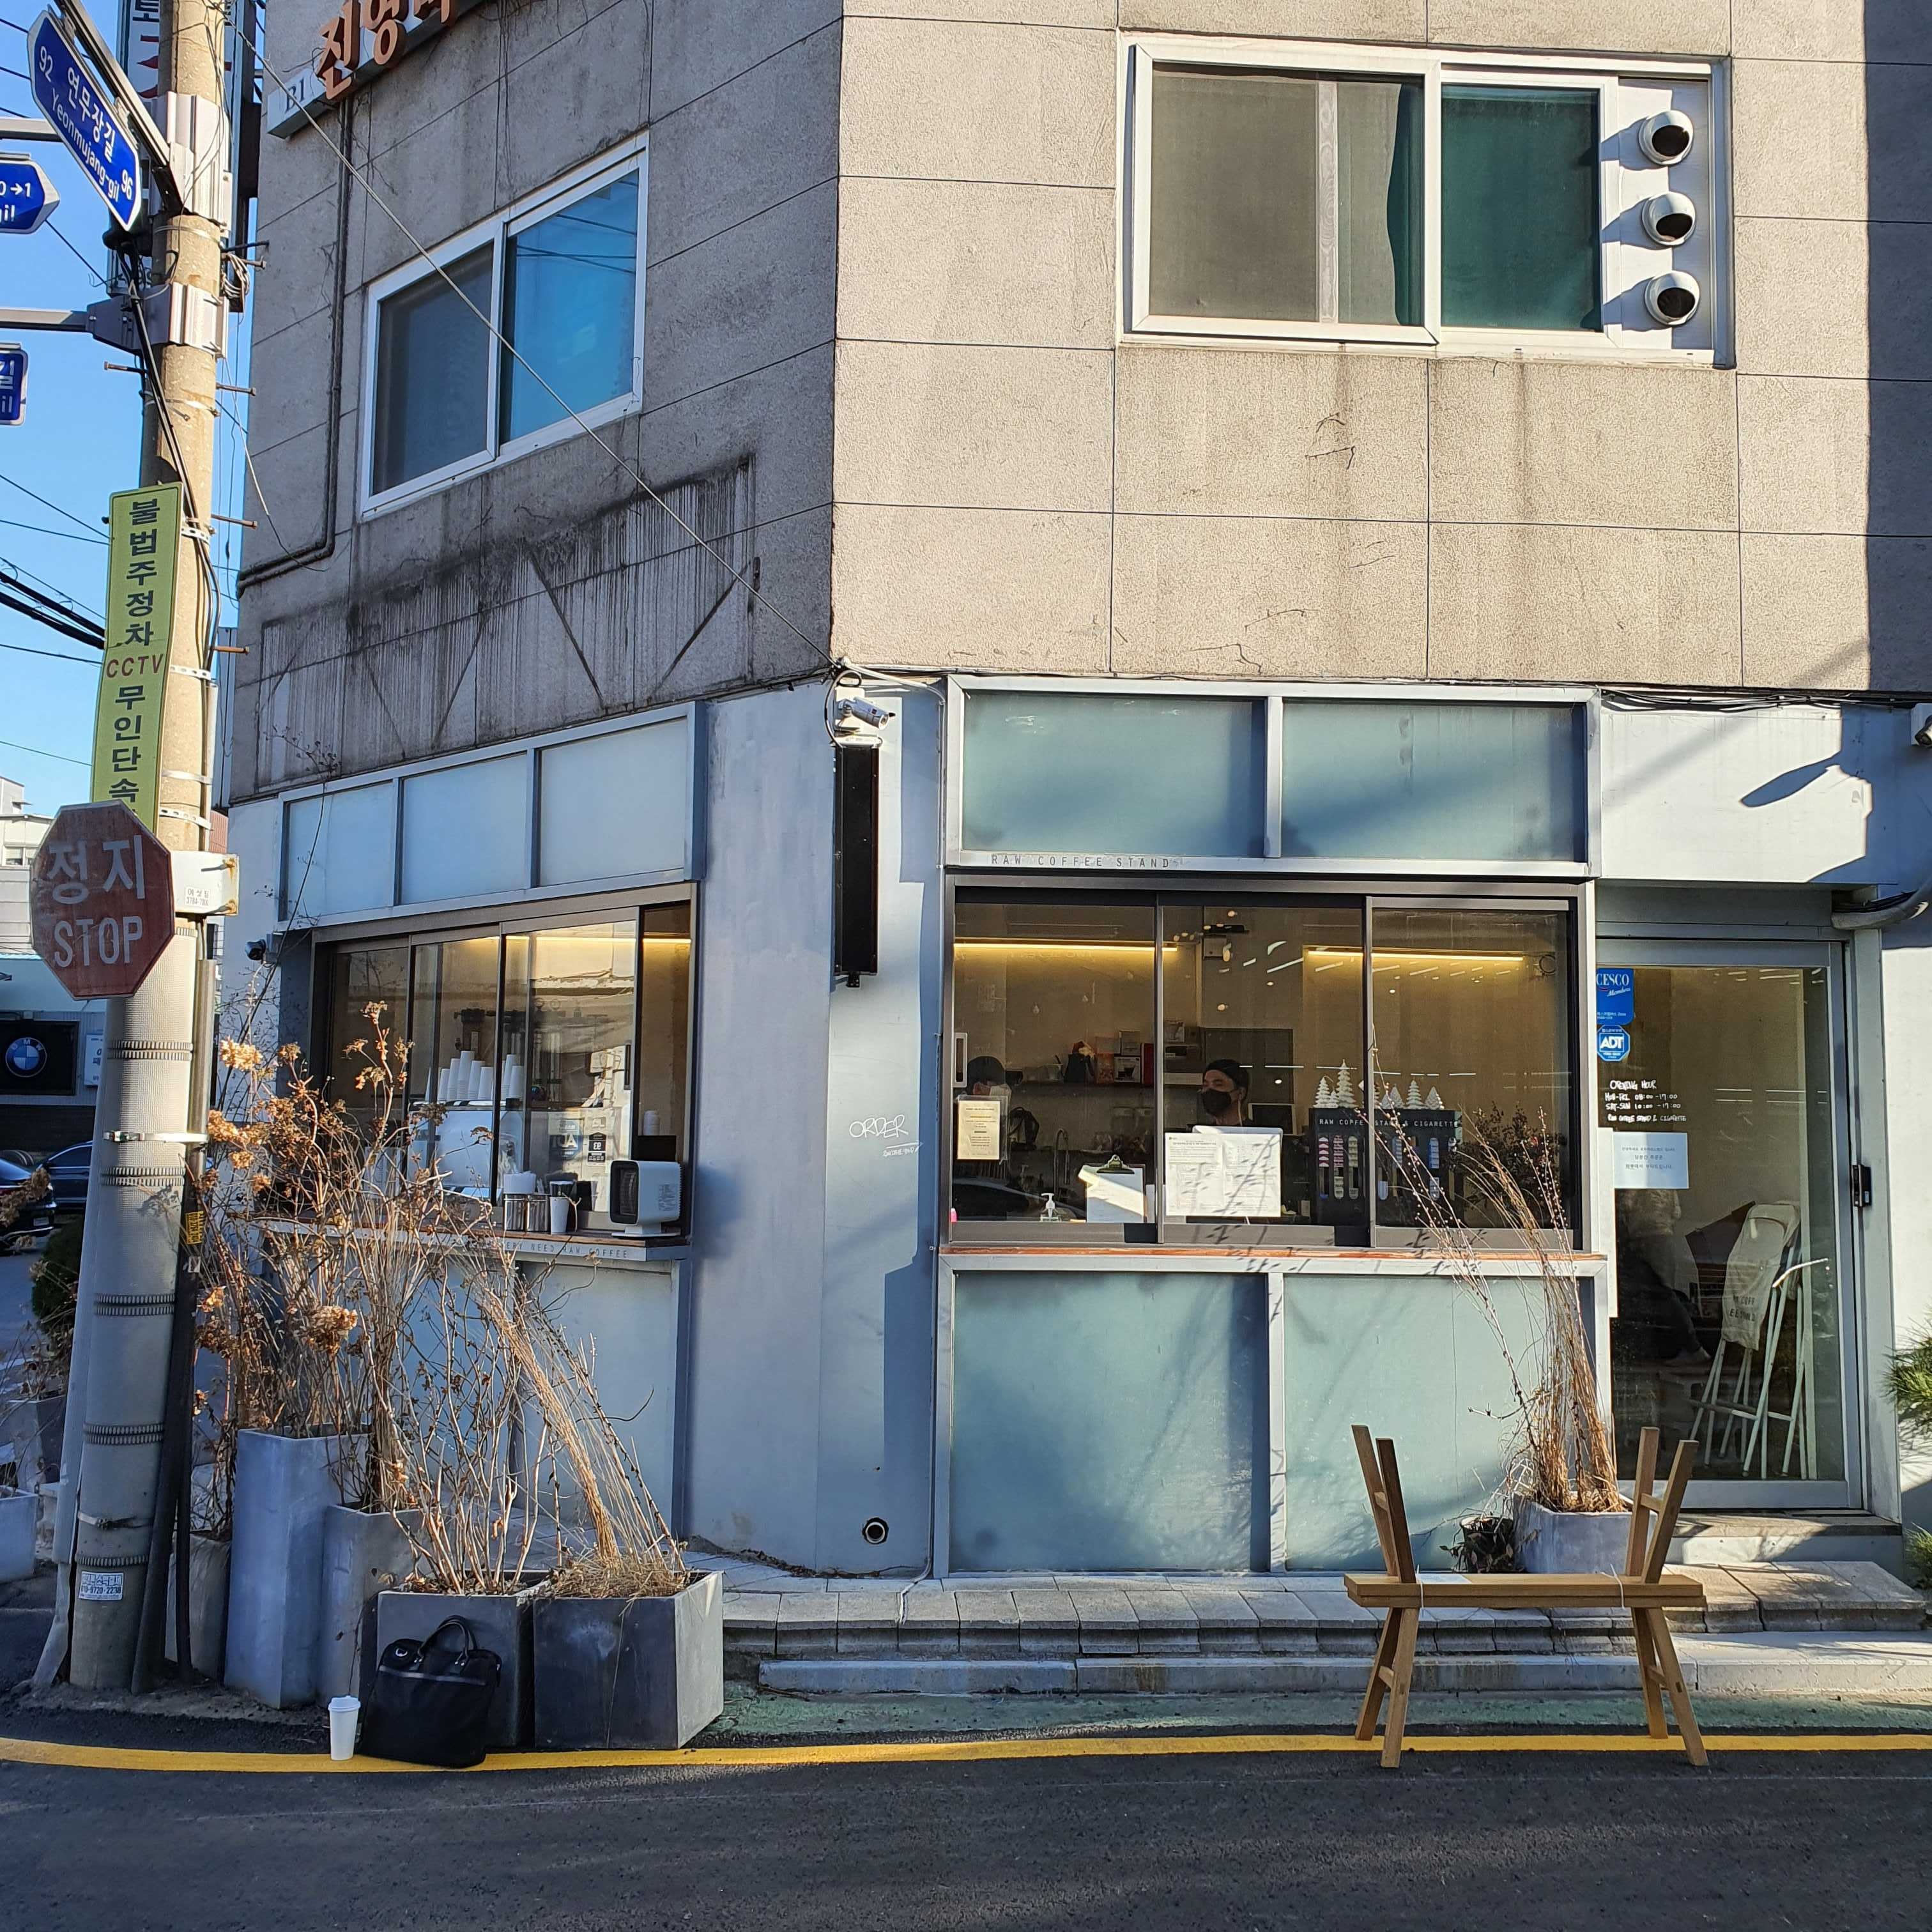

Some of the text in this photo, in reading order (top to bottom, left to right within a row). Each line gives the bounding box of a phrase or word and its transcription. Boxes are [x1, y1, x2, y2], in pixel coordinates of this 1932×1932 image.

[318, 0, 452, 100] 진영
[39, 46, 134, 200] 92 연무장길 96
[51, 88, 119, 203] Yeonmujang-gil
[0, 204, 15, 223] il
[125, 498, 160, 646] 불법주정차
[106, 654, 164, 678] CCTV
[47, 834, 146, 904] 정지
[992, 854, 1169, 868] RAW COFFEE STAND
[54, 916, 143, 967] STOP
[1597, 973, 1630, 986] CESCO
[1600, 1036, 1624, 1049] ADT
[1641, 1080, 1657, 1089] HOUR
[849, 1114, 908, 1138] ORDER
[564, 1246, 581, 1255] RAW
[589, 1248, 628, 1258] COFFEE
